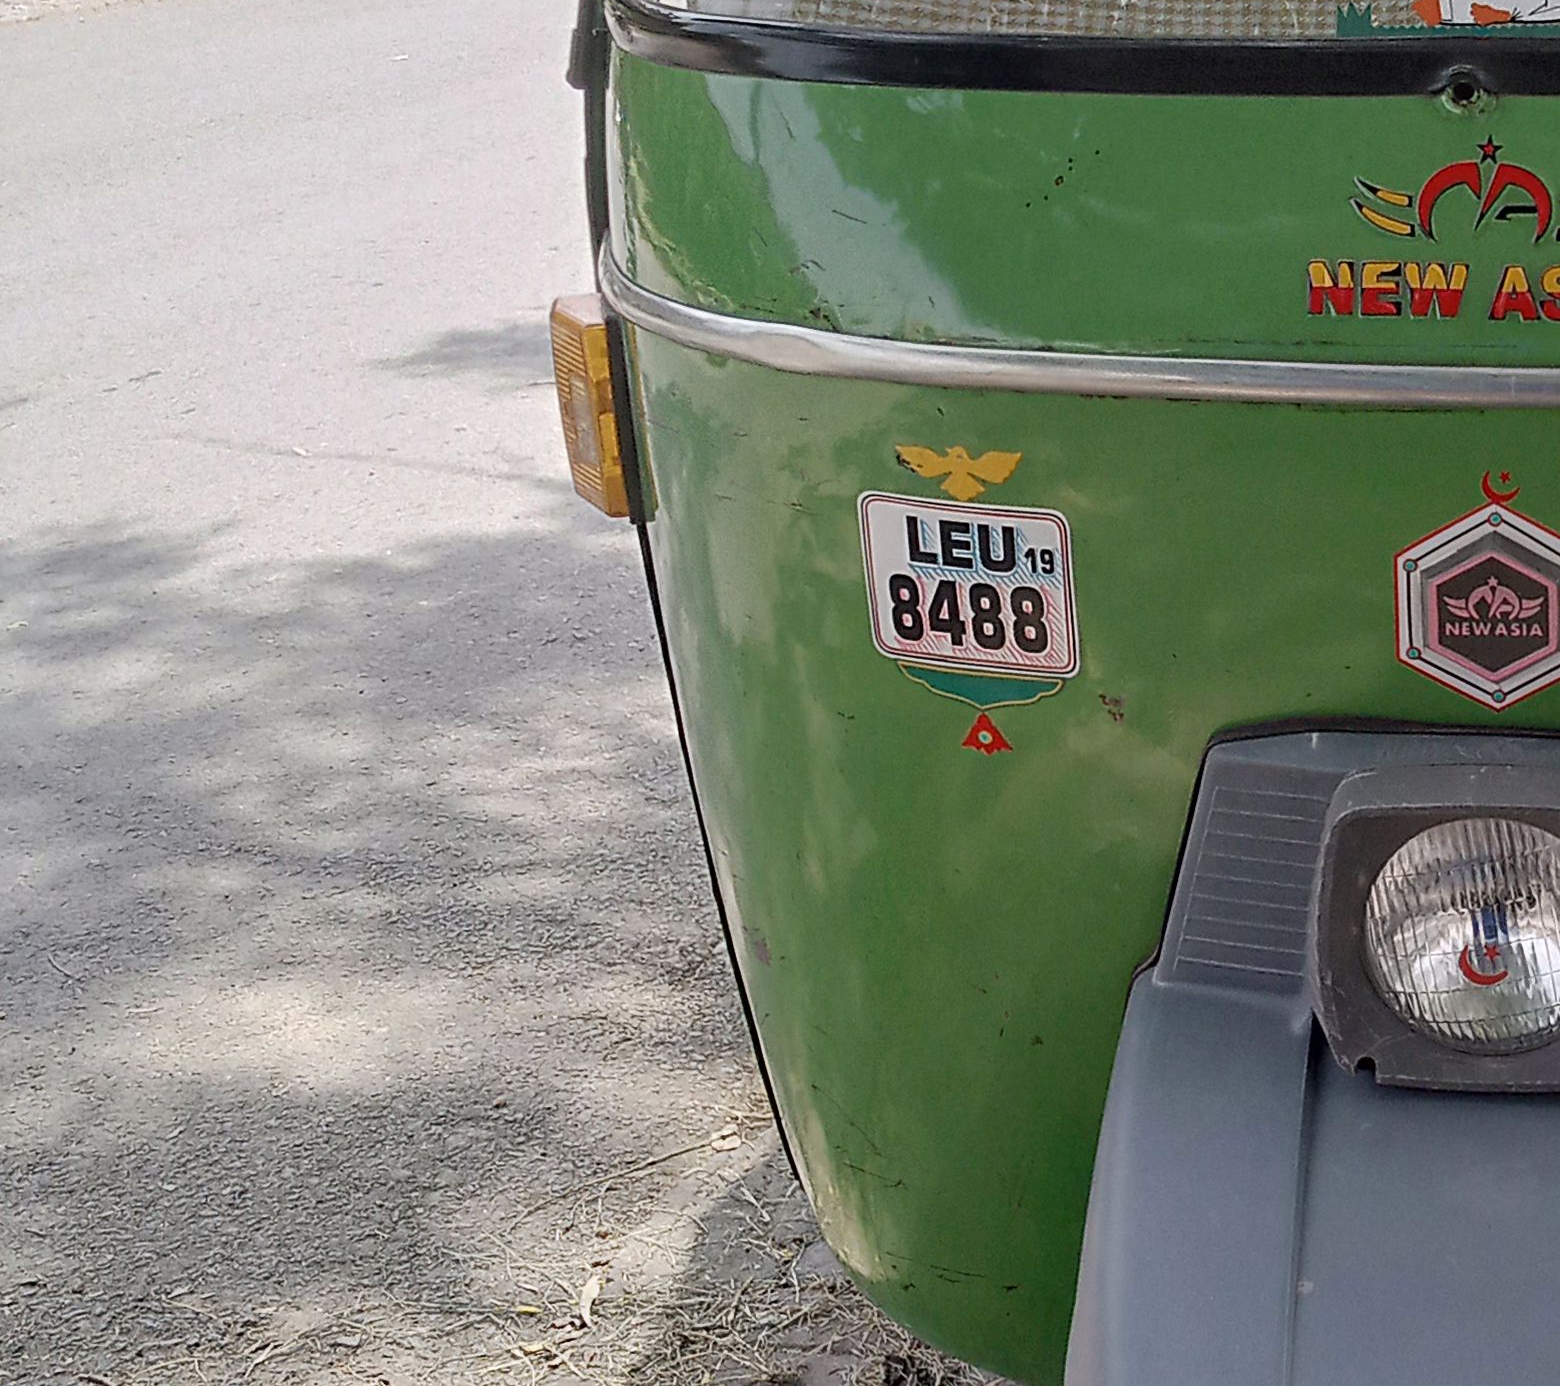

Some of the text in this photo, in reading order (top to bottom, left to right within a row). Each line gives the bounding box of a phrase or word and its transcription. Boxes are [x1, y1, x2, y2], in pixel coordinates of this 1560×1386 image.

[1307, 259, 1470, 320] NEW
[904, 515, 1056, 575] LEU 19
[889, 573, 1049, 654] 8488
[1446, 622, 1543, 636] NEW ASIA
